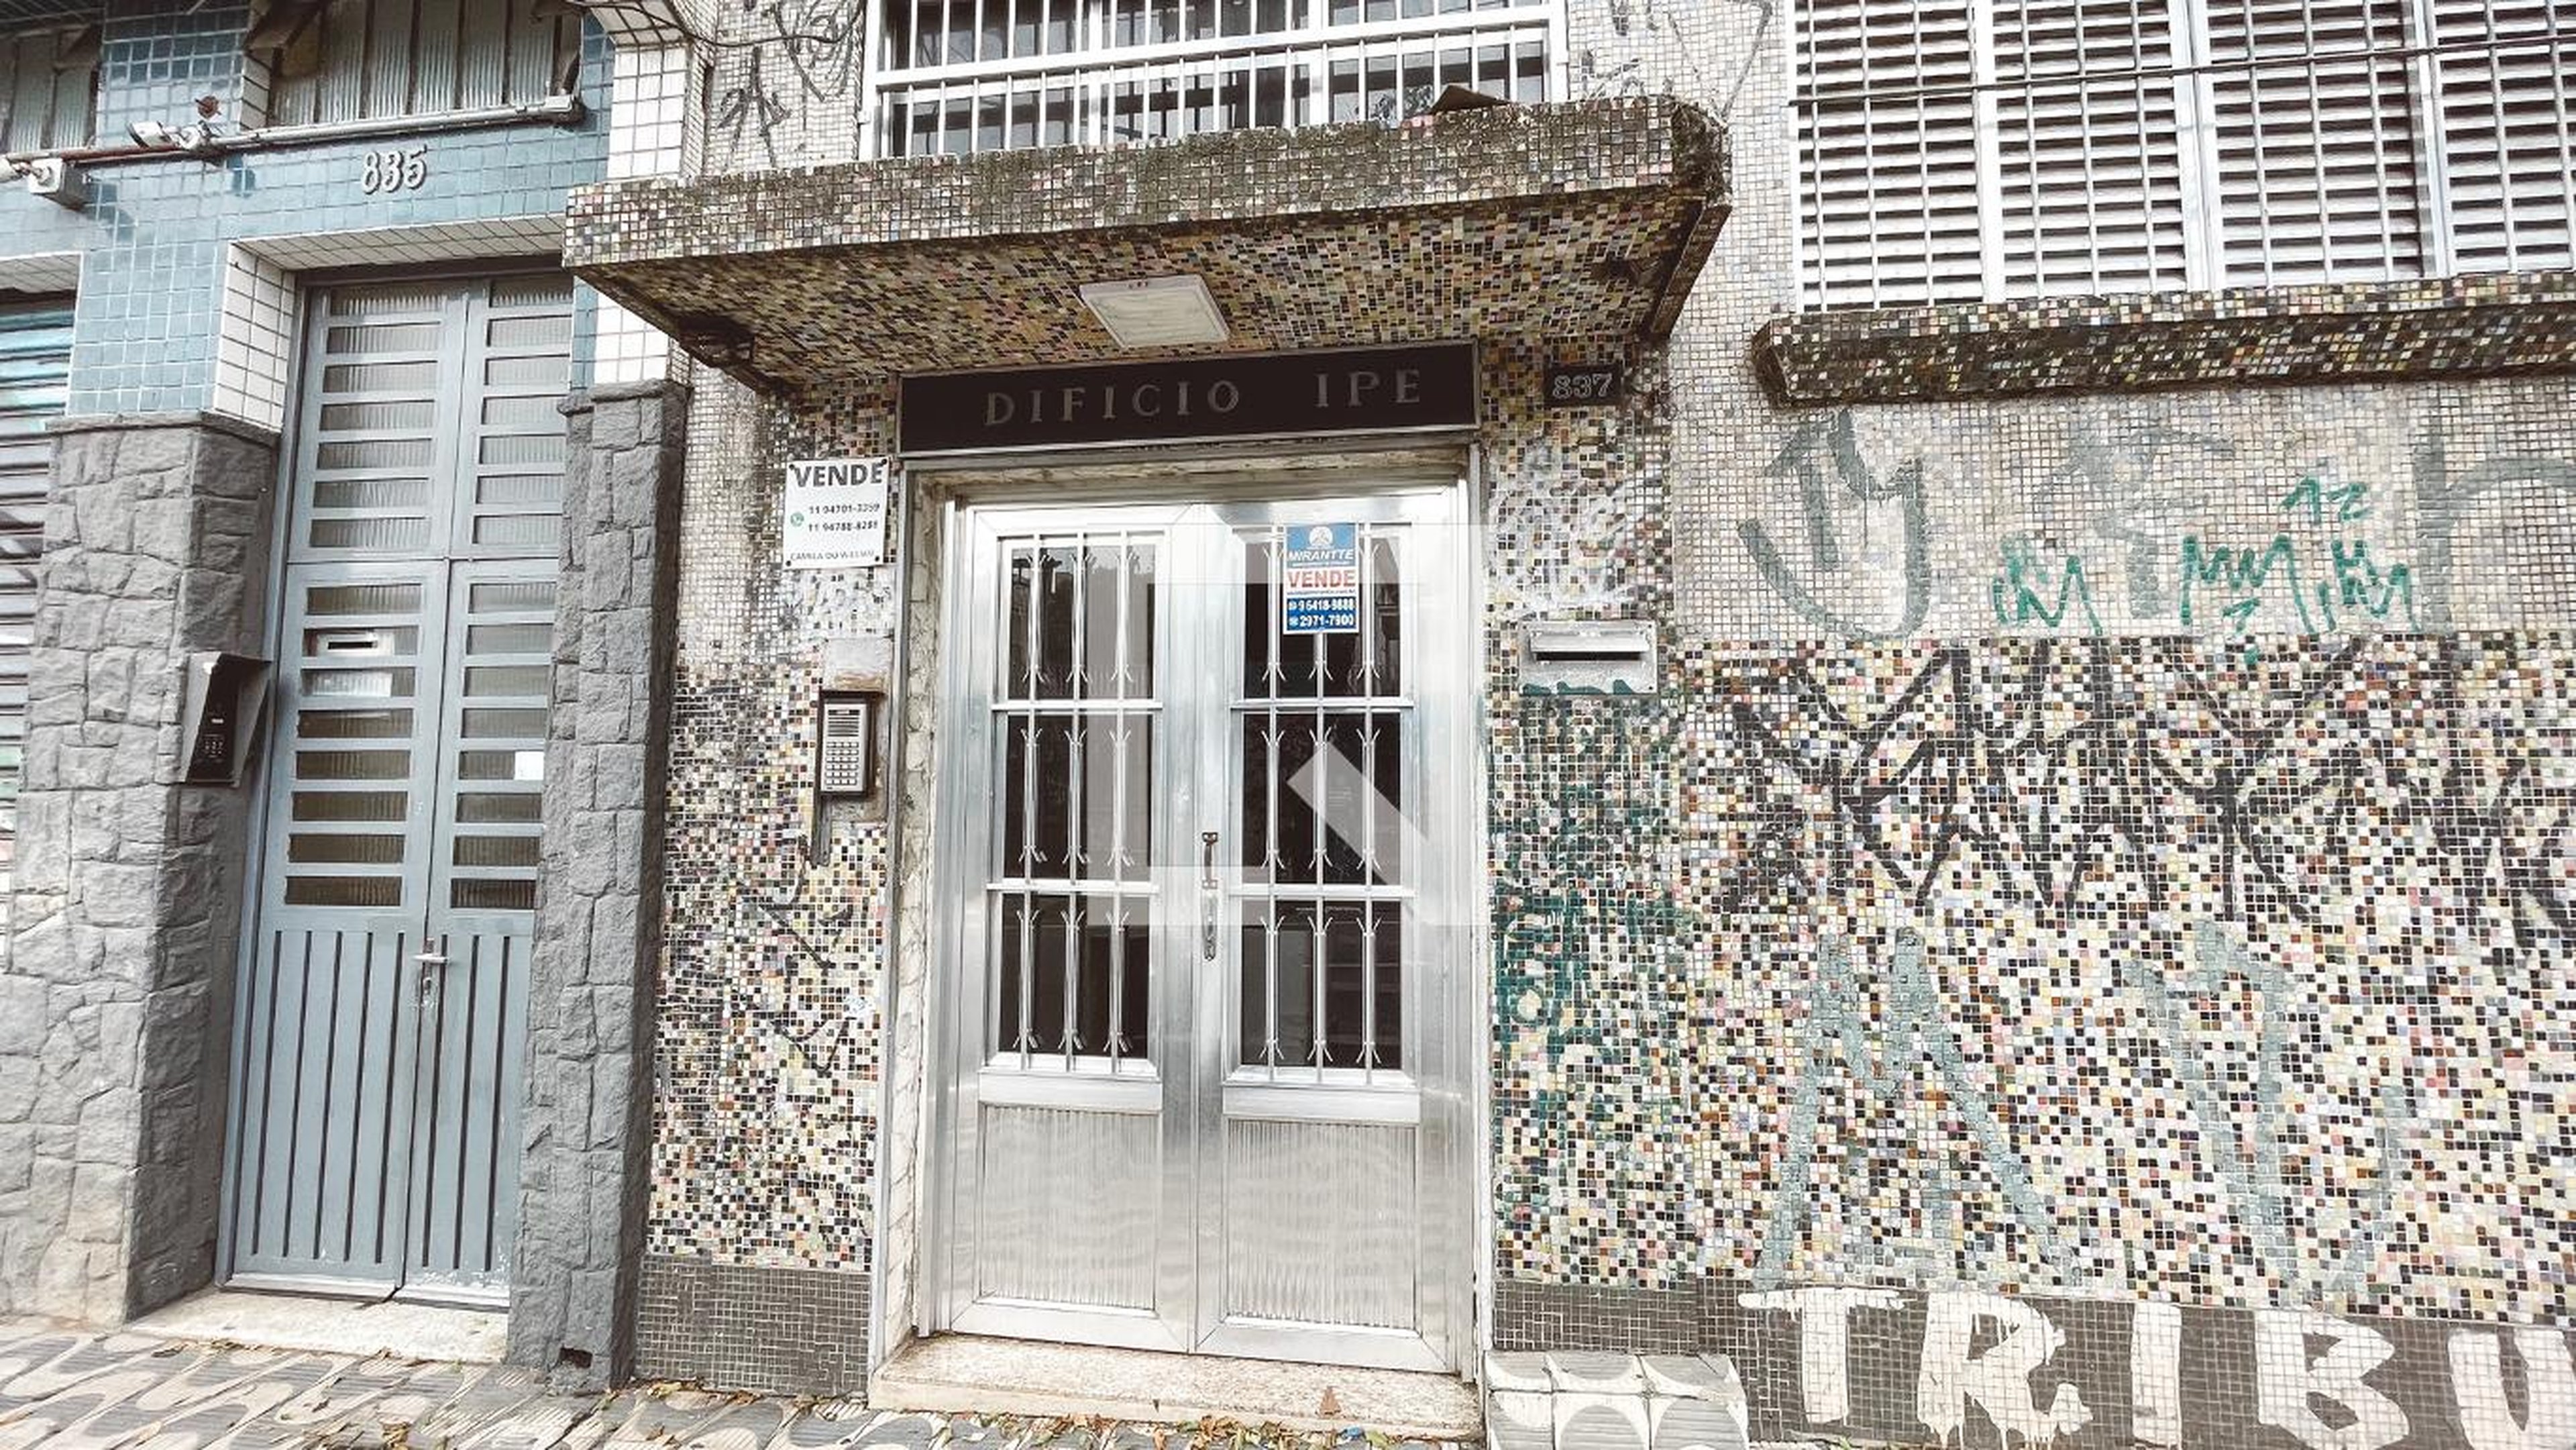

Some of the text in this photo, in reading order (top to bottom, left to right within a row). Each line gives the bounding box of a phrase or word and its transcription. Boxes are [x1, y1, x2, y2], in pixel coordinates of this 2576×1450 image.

[363, 144, 427, 195] 835
[983, 370, 1421, 427] DIFICIO IPE
[1553, 374, 1613, 399] 837
[794, 464, 883, 488] VENDE
[1287, 550, 1354, 562] MIRANTTE
[1287, 571, 1355, 587] VENDE
